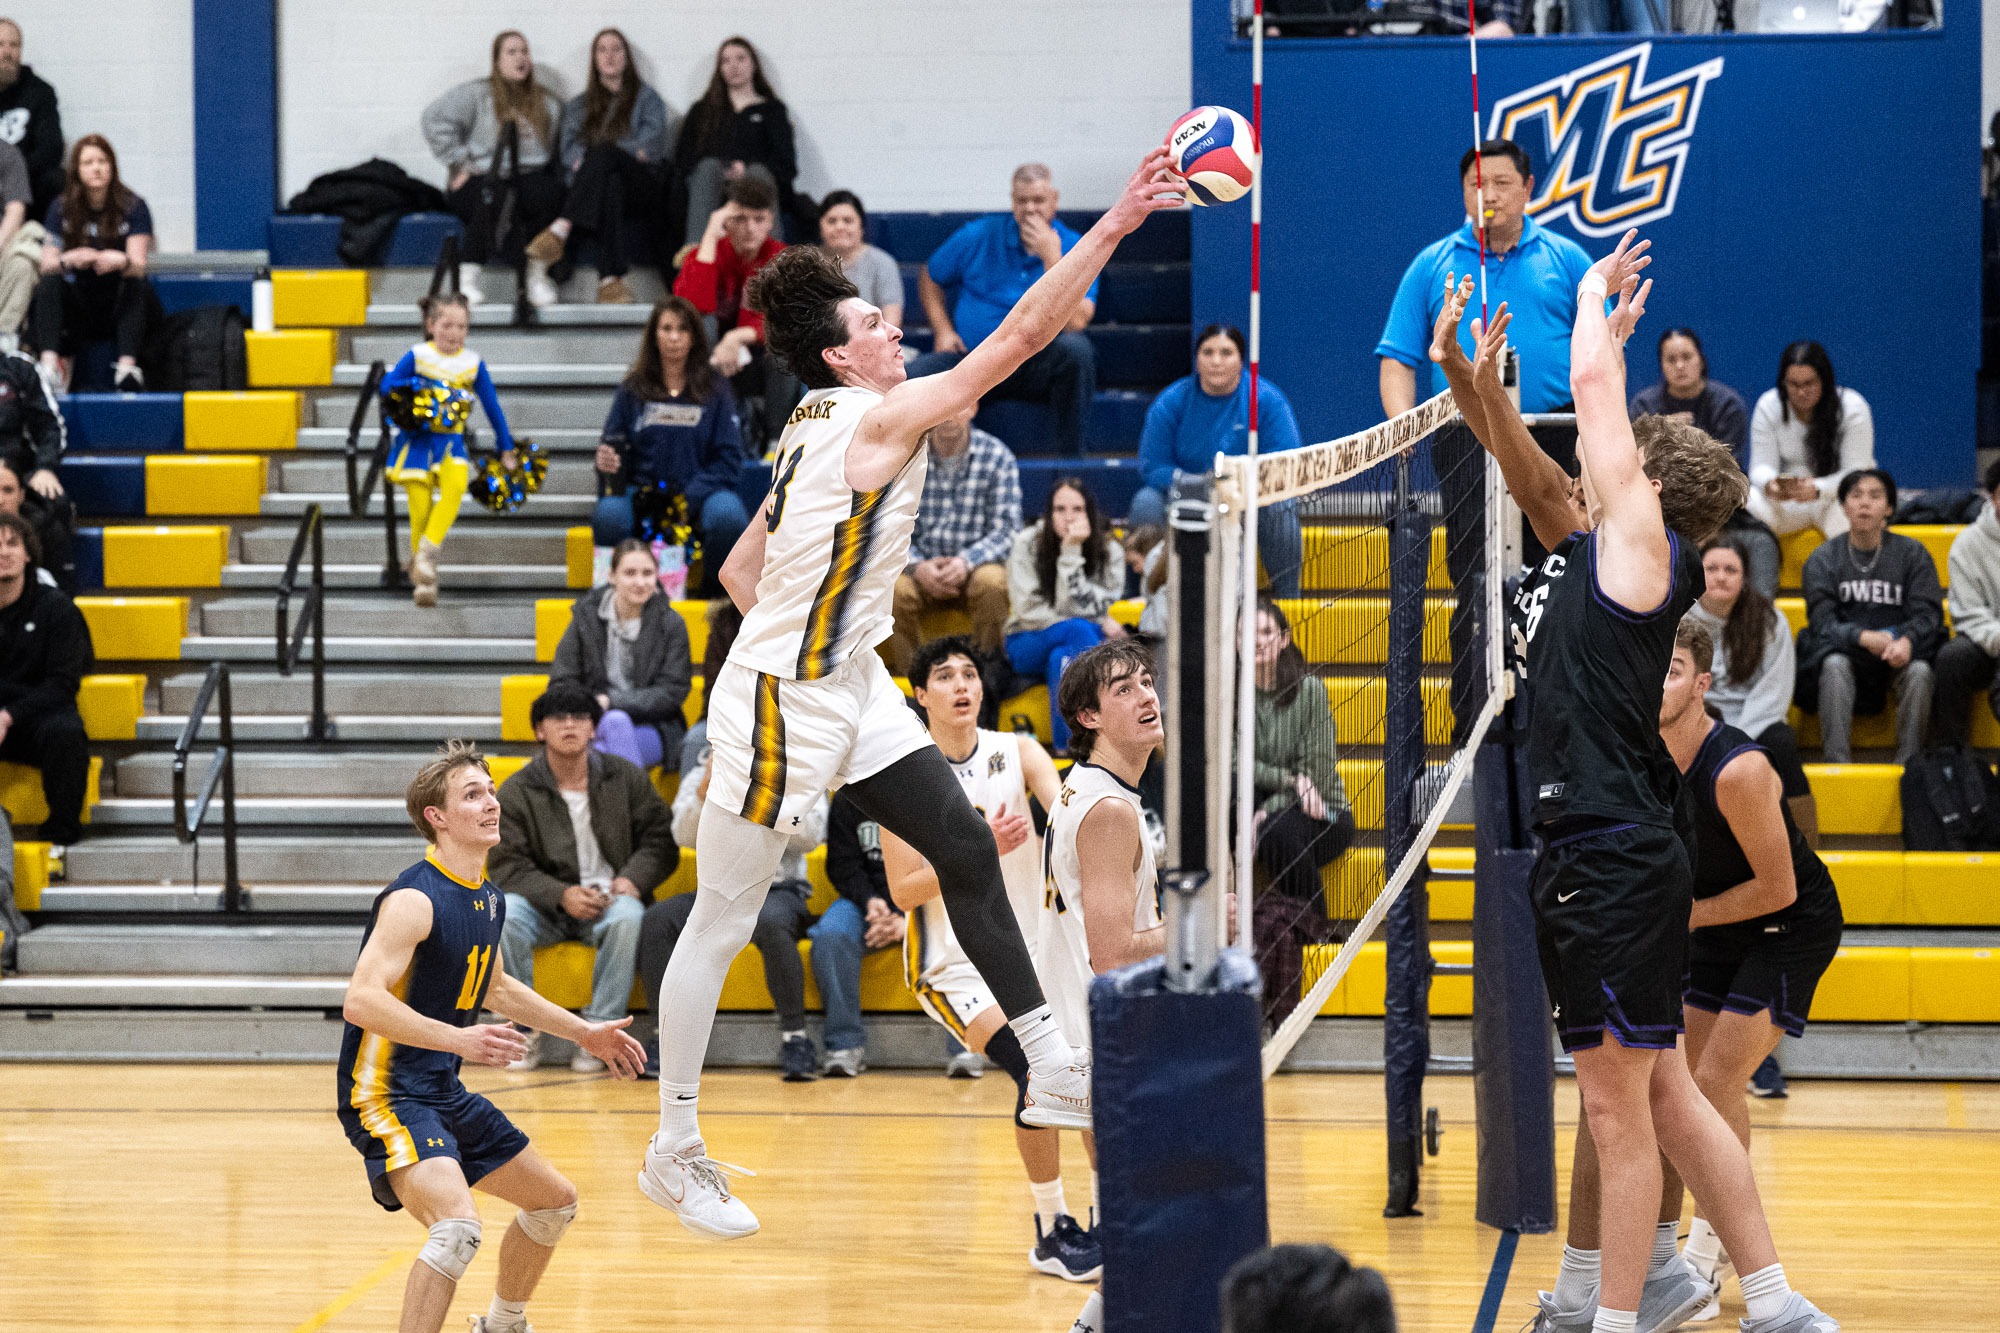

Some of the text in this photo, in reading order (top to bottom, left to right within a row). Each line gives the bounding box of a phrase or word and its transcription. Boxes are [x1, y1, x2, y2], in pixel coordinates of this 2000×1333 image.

[1174, 121, 1207, 146] NCAA
[1484, 42, 1724, 238] MC
[455, 944, 492, 1011] 11
